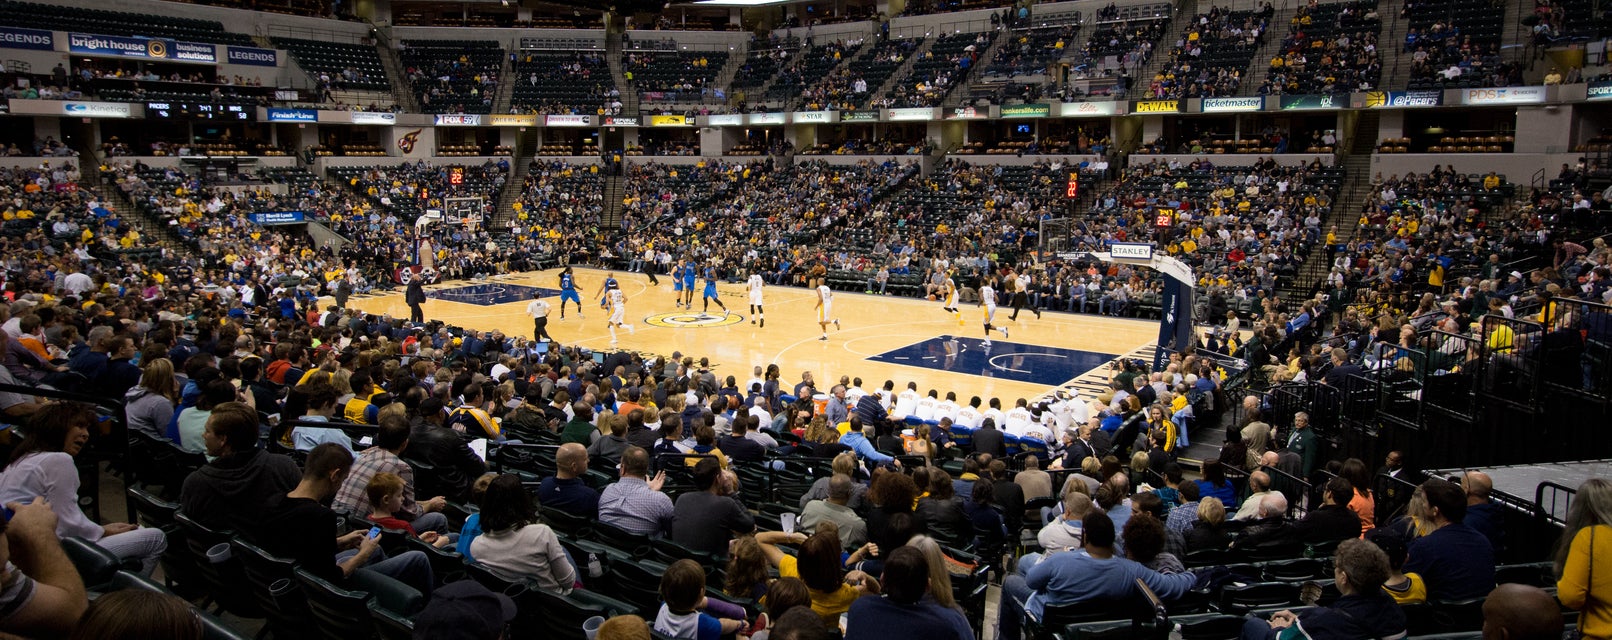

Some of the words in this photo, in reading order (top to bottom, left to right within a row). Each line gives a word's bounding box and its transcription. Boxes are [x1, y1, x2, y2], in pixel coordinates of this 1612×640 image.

[0, 32, 51, 45] EGENDS
[71, 37, 109, 50] bright
[110, 39, 146, 51] house
[176, 43, 212, 53] business
[177, 51, 214, 61] solutions
[229, 50, 275, 62] LEGENDS
[1469, 89, 1496, 99] PDS
[1205, 99, 1260, 108] ticketmaster
[1393, 95, 1438, 106] @Pacers
[90, 104, 128, 113] Kinetico
[1001, 106, 1049, 115] bankerslife.com
[443, 115, 461, 124] FOX
[463, 115, 473, 124] 59
[451, 174, 462, 184] 22
[1068, 182, 1076, 197] 22
[1156, 216, 1169, 226] 22
[1113, 247, 1149, 255] STANLEY
